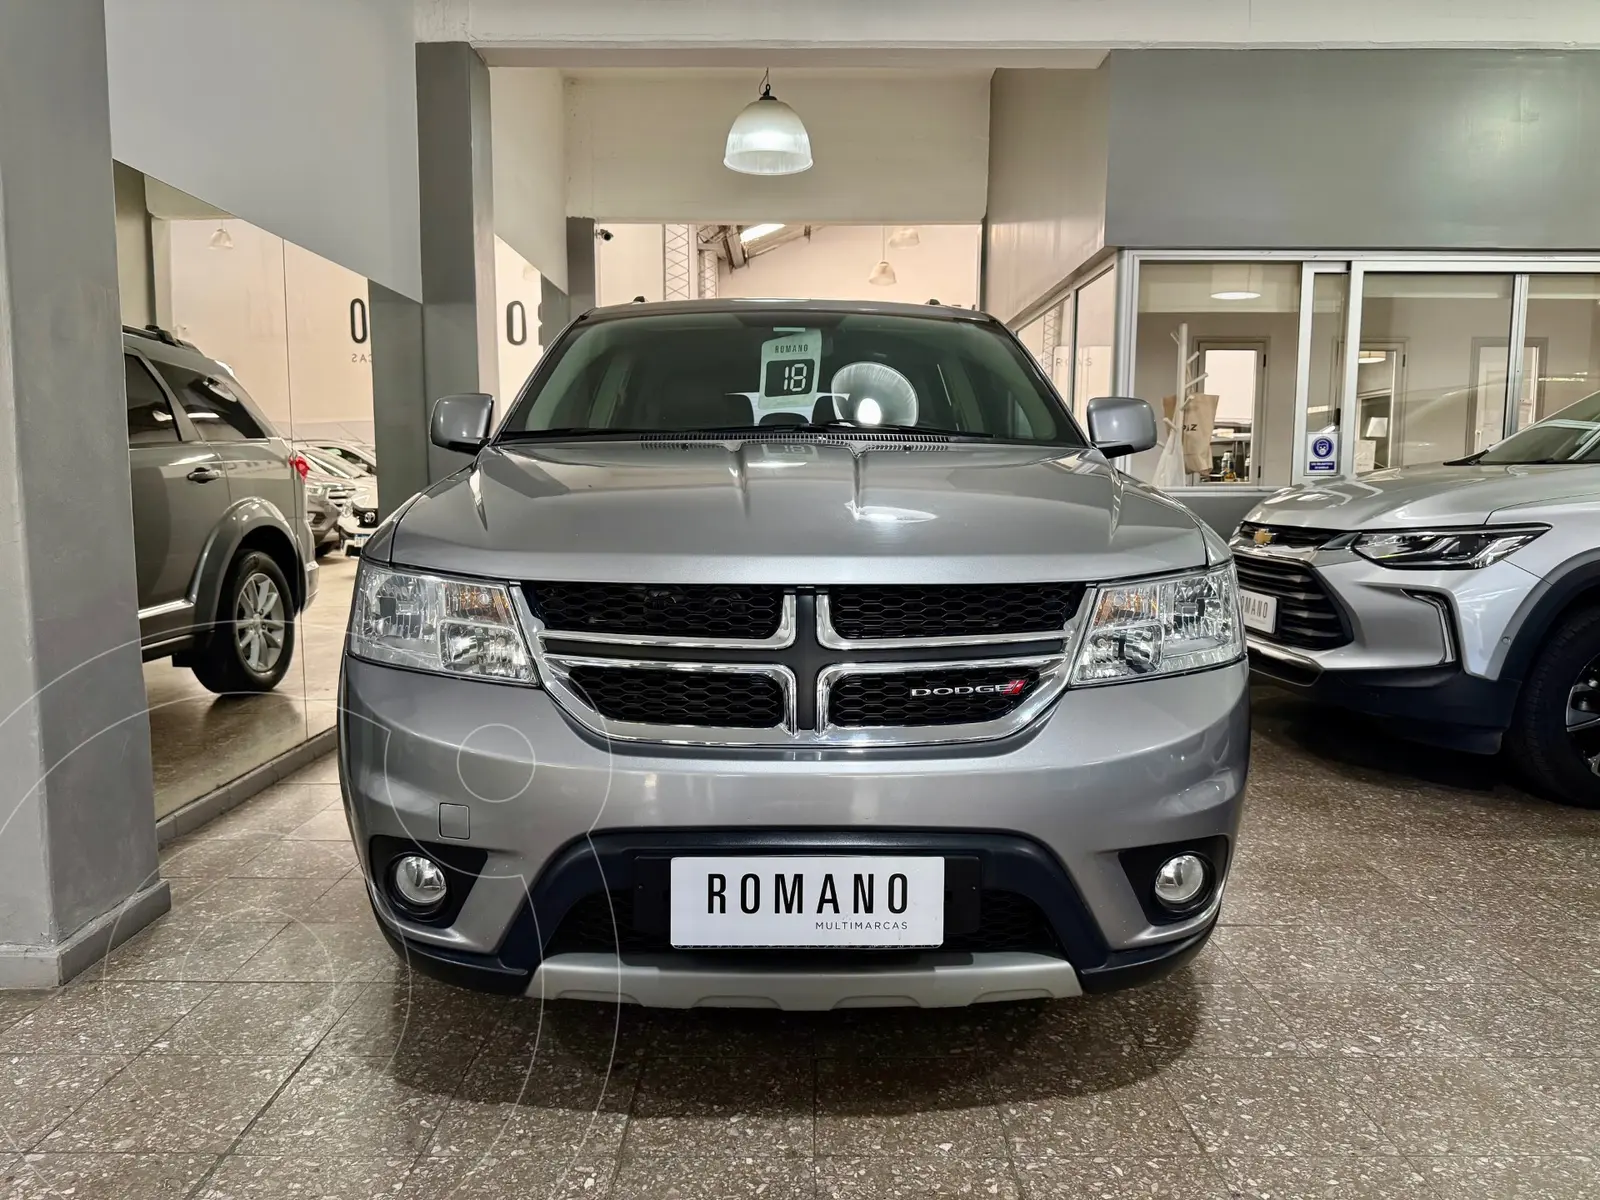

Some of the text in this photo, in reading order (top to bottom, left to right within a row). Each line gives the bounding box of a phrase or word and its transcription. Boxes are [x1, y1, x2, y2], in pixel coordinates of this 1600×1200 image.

[774, 344, 809, 354] ROMANO
[783, 363, 808, 392] 18
[911, 683, 1014, 697] DODGE
[707, 873, 908, 915] ROMANO
[815, 921, 908, 931] MULTIMARCAS
